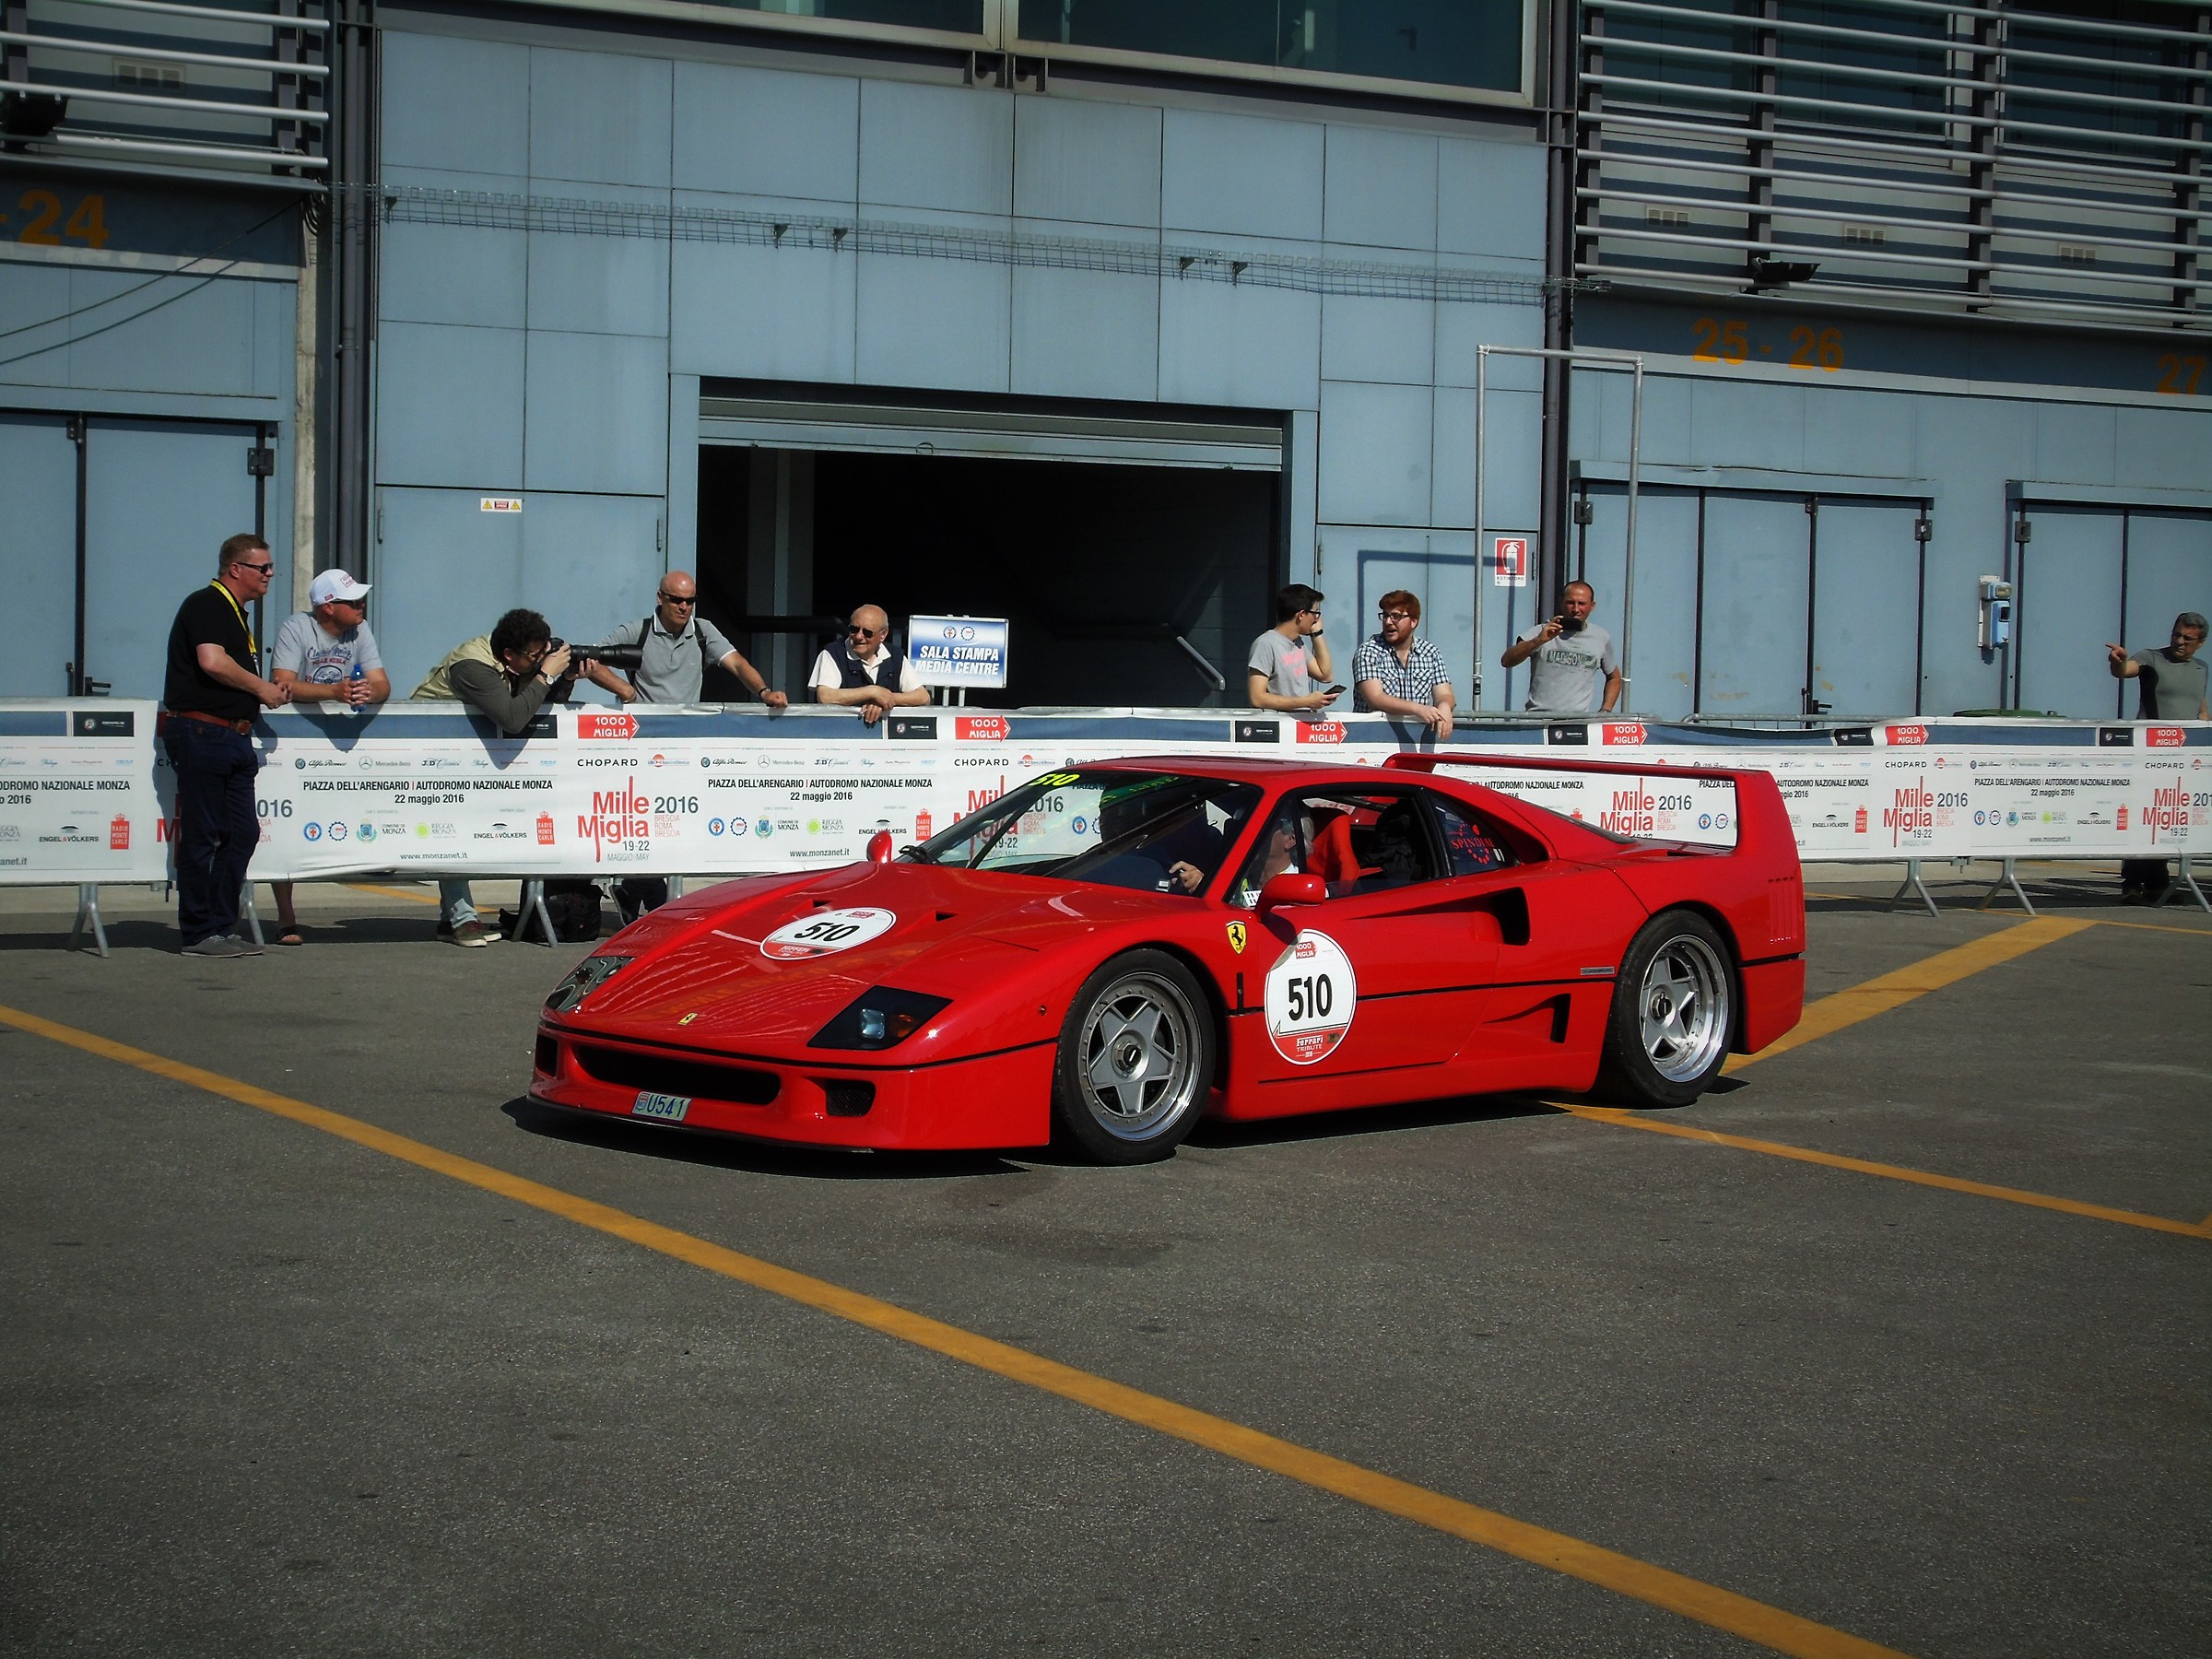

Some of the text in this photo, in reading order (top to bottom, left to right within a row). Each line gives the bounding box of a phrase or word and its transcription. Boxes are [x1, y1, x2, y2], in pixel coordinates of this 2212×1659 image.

[19, 189, 110, 250] 24
[1692, 318, 1748, 365] 25
[1788, 325, 1843, 373] 26
[2157, 354, 2206, 397] 27
[920, 645, 999, 661] SALA STAMPA
[914, 661, 1000, 675] MEDIA CENTRE
[595, 717, 626, 725] 1000
[971, 719, 998, 727] 1000
[594, 728, 629, 737] MIGLIA
[969, 730, 1001, 738] MIGLIA
[1311, 724, 1336, 732] 1000
[1309, 735, 1338, 743] MIGLIA
[577, 759, 638, 767] CHOPARD
[303, 781, 553, 791] PIAZZA DELL'ARENGARIO AUTODROMO NAZIONALE MONZA
[708, 779, 933, 788] PIAZZA DELL'ARENGARIO AUTODROMO NAZIONALE MONZA
[1028, 773, 1080, 786] 510
[1525, 782, 1560, 790] NAZIONALE
[1699, 780, 1721, 788] PIAZZA
[41, 782, 94, 791] NAZIONALE
[97, 782, 130, 790] MONZA
[968, 775, 1005, 811] Mill
[1895, 775, 1935, 808] Mille
[2154, 776, 2191, 806] Mille
[8, 795, 31, 804] 2016
[394, 794, 465, 805] 22 maggio 2016
[593, 775, 650, 815] Mille
[790, 792, 853, 802] 22 maggio 2016
[1612, 777, 1655, 811] Mille
[1936, 793, 1969, 807] 2016
[2040, 789, 2059, 798] maggio
[2193, 793, 2212, 806] 201
[257, 799, 293, 818] 016
[654, 796, 699, 814] 2016
[1028, 796, 1064, 813] 016
[1658, 795, 1692, 810] 2016
[1600, 812, 1653, 837] Miglia
[1883, 808, 1933, 848] Miglia
[2143, 807, 2189, 845] Miglia
[1912, 830, 1933, 838] 19-22
[2170, 828, 2188, 837] 19-22
[577, 815, 650, 864] Miglia
[622, 841, 650, 852] 19-22
[790, 848, 850, 857] www.monzanet.it
[400, 852, 468, 861] www.monzanet.it
[606, 853, 650, 862] MAGGIO MAY
[794, 922, 861, 942] 510
[1288, 973, 1333, 1021] 510
[1296, 1034, 1324, 1047] Ferrari
[1297, 1043, 1323, 1053] TRIBUTE
[647, 1094, 686, 1118] U541
